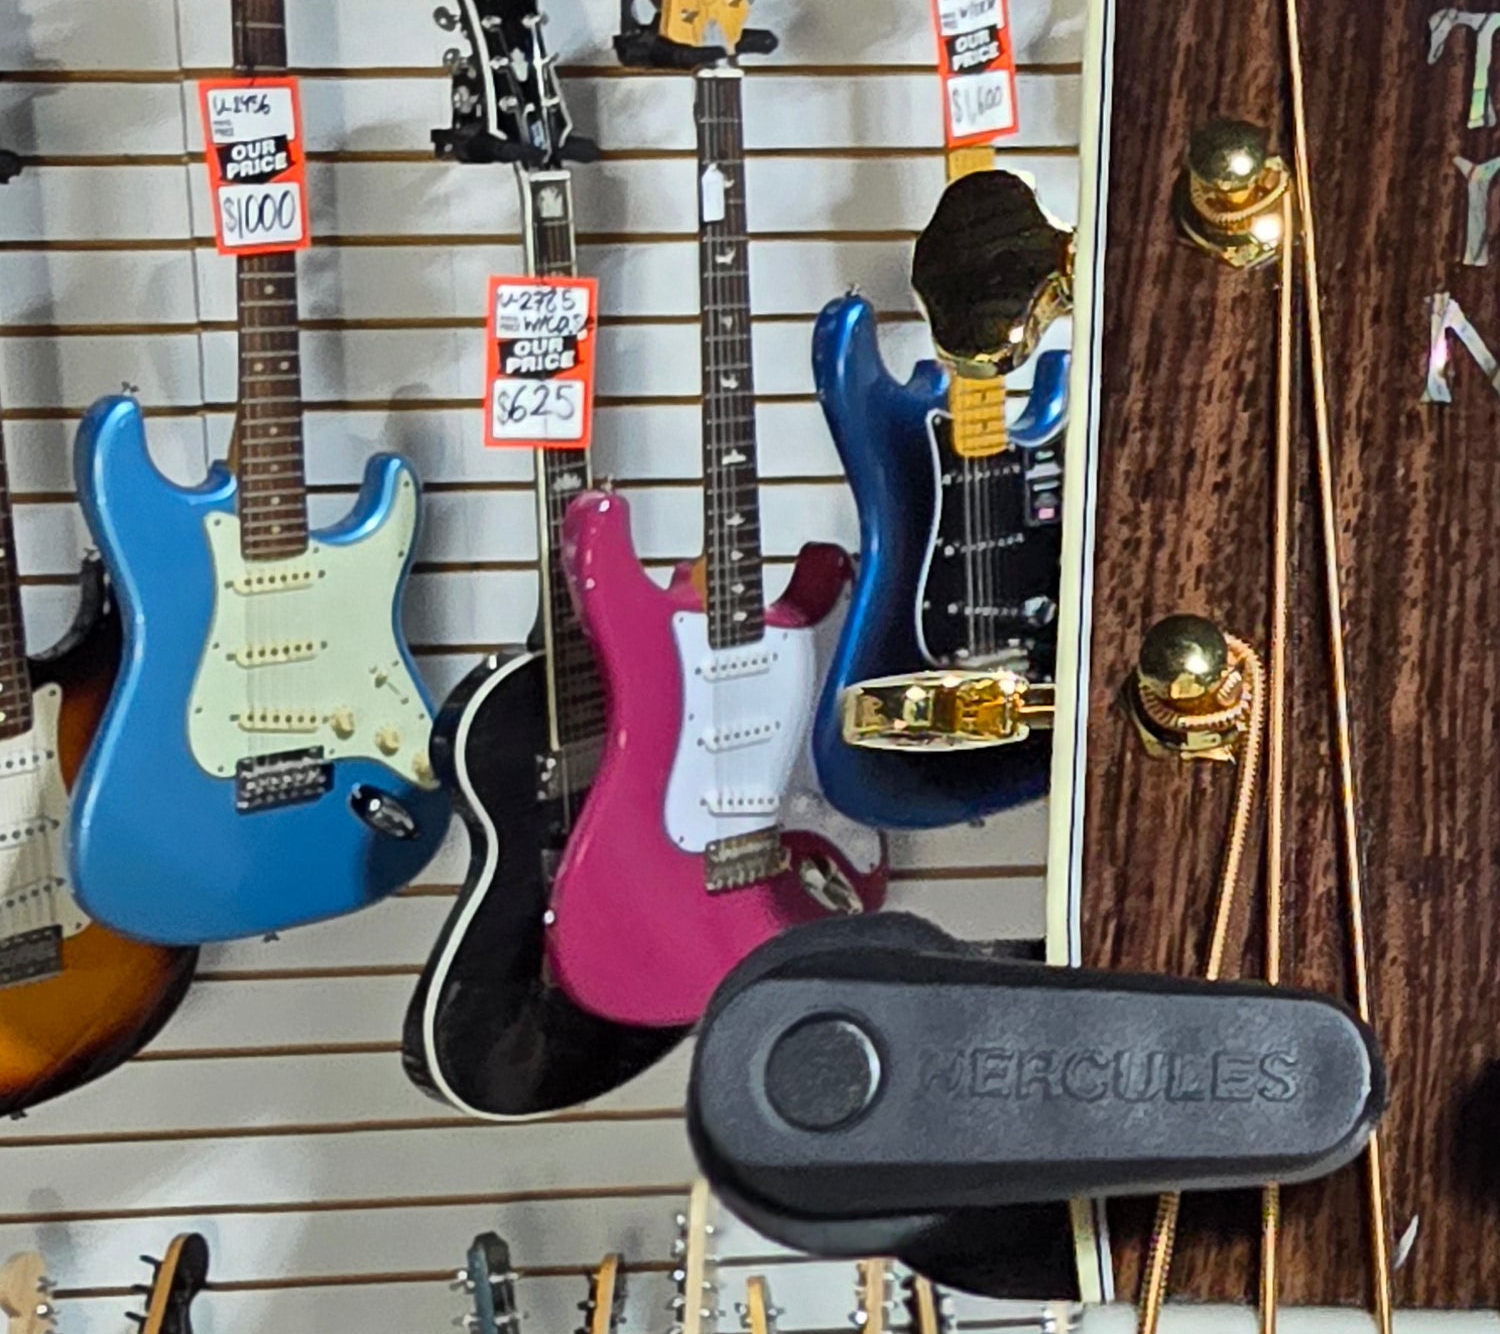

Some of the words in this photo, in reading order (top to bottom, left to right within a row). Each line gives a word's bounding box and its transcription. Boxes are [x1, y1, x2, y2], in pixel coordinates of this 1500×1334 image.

[955, 28, 990, 53] OUR
[952, 40, 1000, 72] PRICE
[231, 139, 276, 161] OUR
[226, 152, 288, 181] PRICE
[224, 190, 296, 238] $1000
[513, 337, 564, 356] OUR
[506, 350, 576, 375] PRICE
[498, 385, 575, 425] $625
[919, 1046, 1300, 1104] HERCULES
